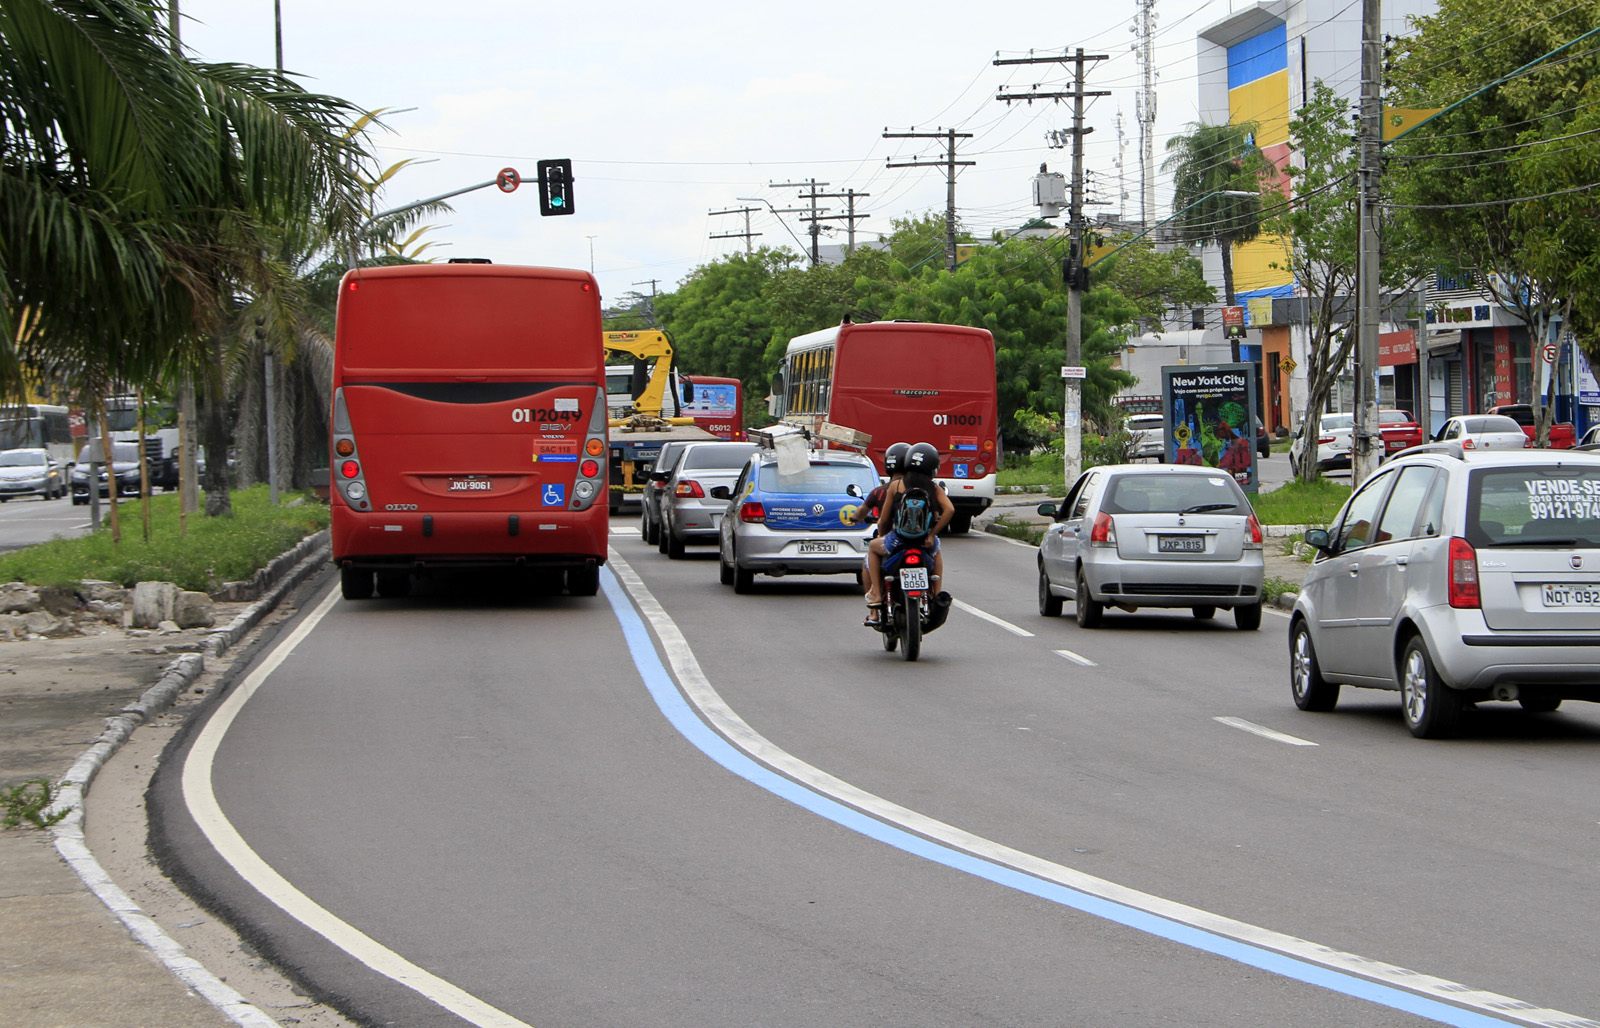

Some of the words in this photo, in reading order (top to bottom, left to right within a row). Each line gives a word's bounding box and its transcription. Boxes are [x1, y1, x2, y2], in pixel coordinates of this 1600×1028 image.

[1172, 377, 1196, 387] New
[1197, 376, 1221, 385] York
[1222, 374, 1245, 386] City
[709, 424, 731, 432] 05012
[450, 481, 491, 490] JXU-9061
[1525, 480, 1600, 494] VENDE-SE
[1530, 502, 1600, 519] 99121-974
[799, 544, 836, 552] AYH-5331
[1162, 541, 1201, 549] JXP-1815
